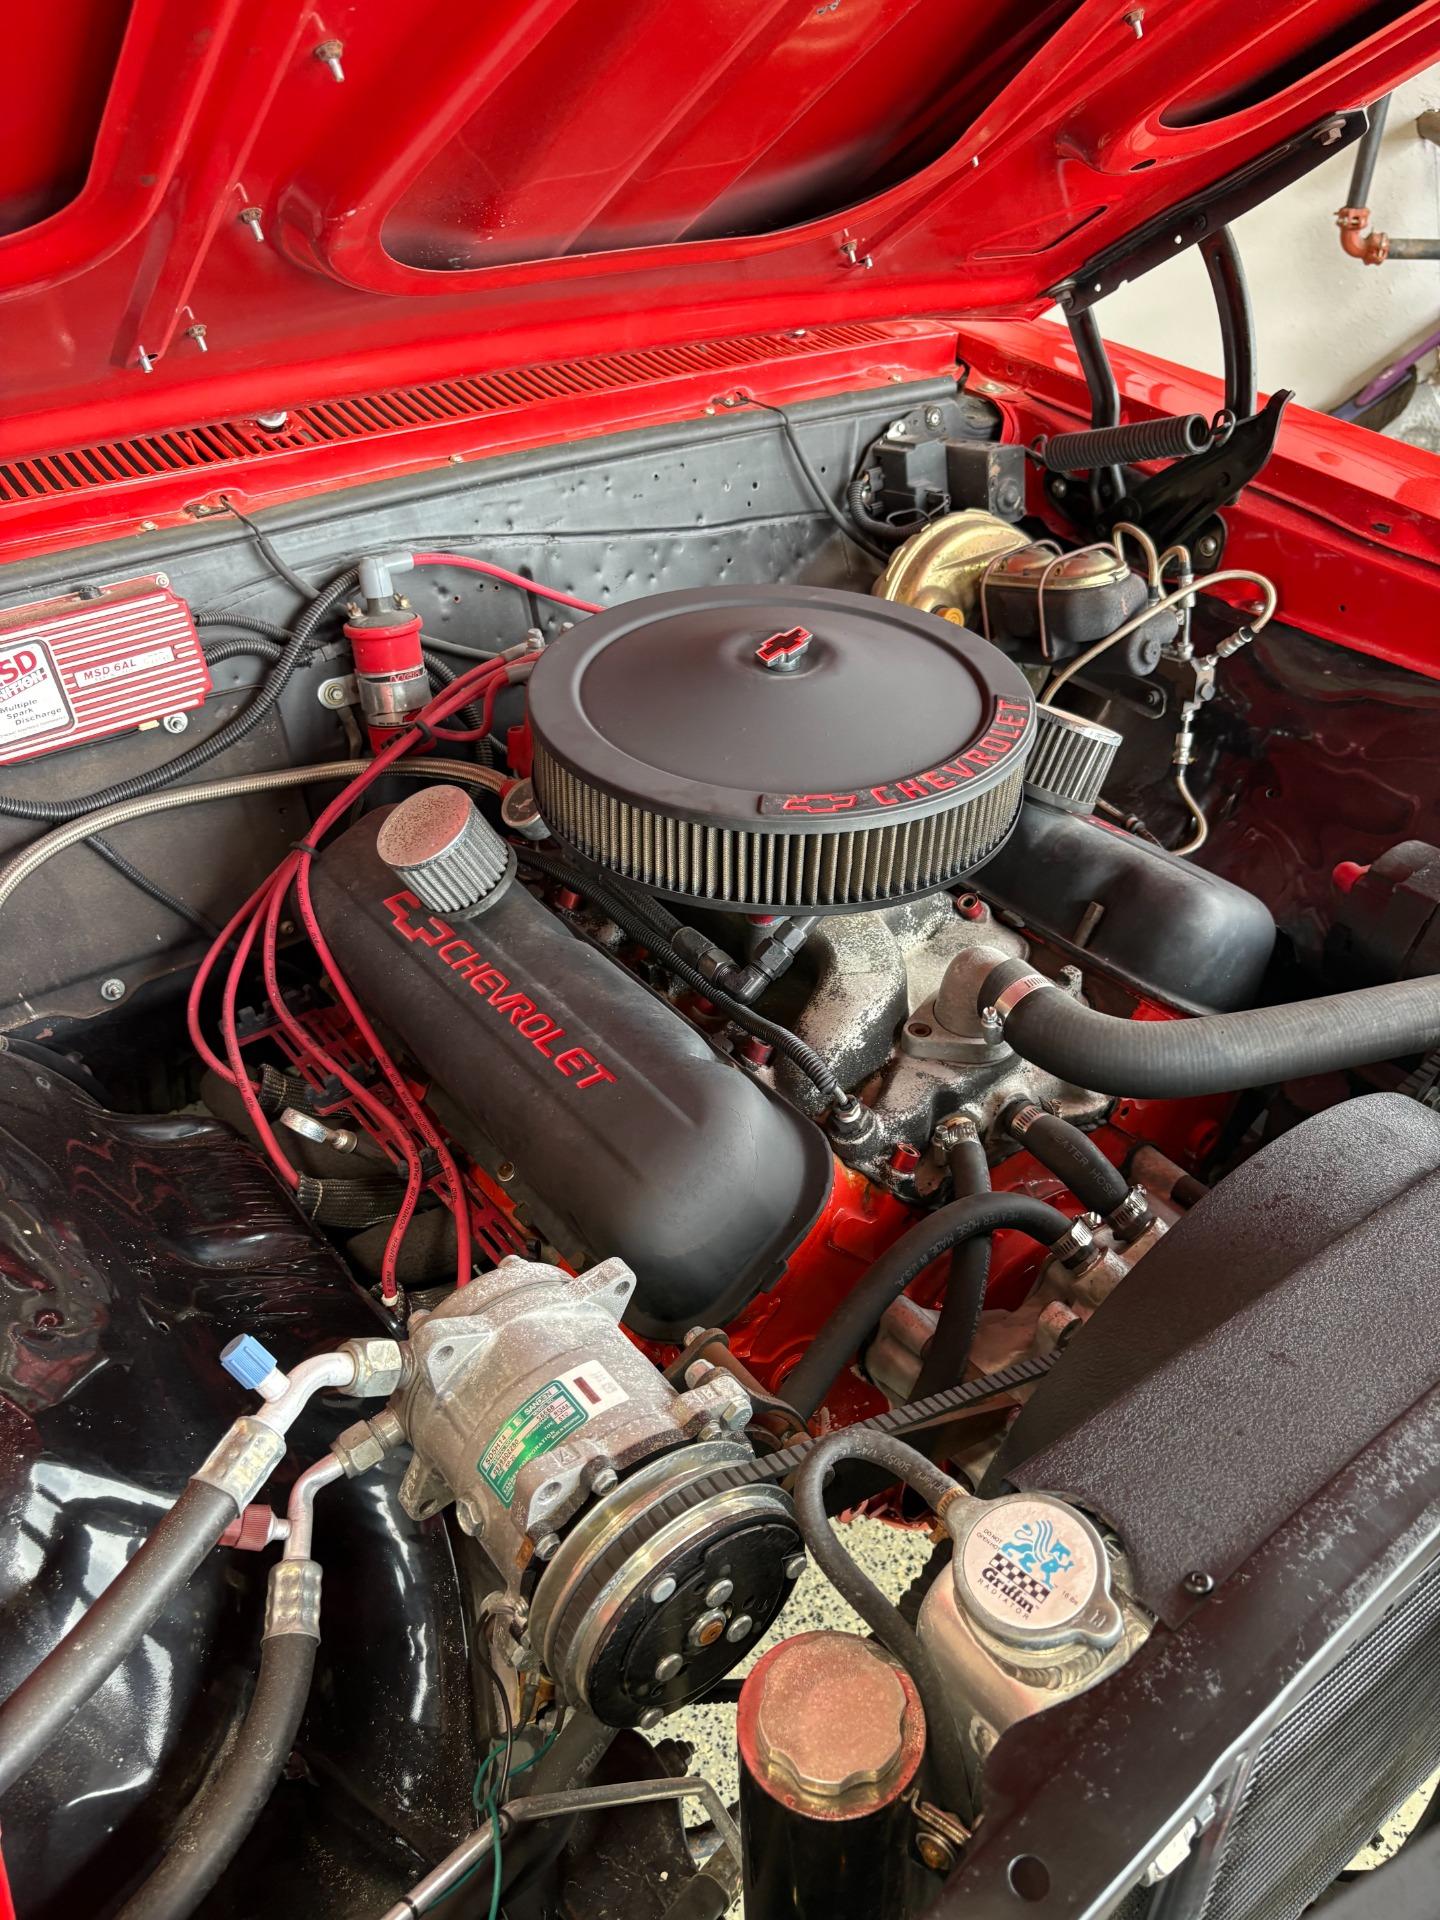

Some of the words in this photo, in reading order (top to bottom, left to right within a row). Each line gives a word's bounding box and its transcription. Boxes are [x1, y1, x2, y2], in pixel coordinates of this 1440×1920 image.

[0, 651, 37, 687] SD
[83, 666, 110, 680] MSD
[114, 659, 136, 671] 6AL
[0, 700, 38, 714] Multiple
[6, 708, 34, 720] Spark
[15, 708, 62, 726] Discharge
[870, 699, 1028, 805] CHEVROLET
[438, 939, 617, 1089] CHEVROLET
[1089, 1167, 1118, 1198] HOSE
[388, 1236, 400, 1264] SUPER
[398, 1186, 417, 1230] CONDUCTOR
[930, 1233, 954, 1256] MADE
[983, 1528, 992, 1537] DO
[977, 1578, 1029, 1620] RADIATOR
[982, 1567, 1034, 1613] Griffin
[576, 1737, 606, 1777] MADE
